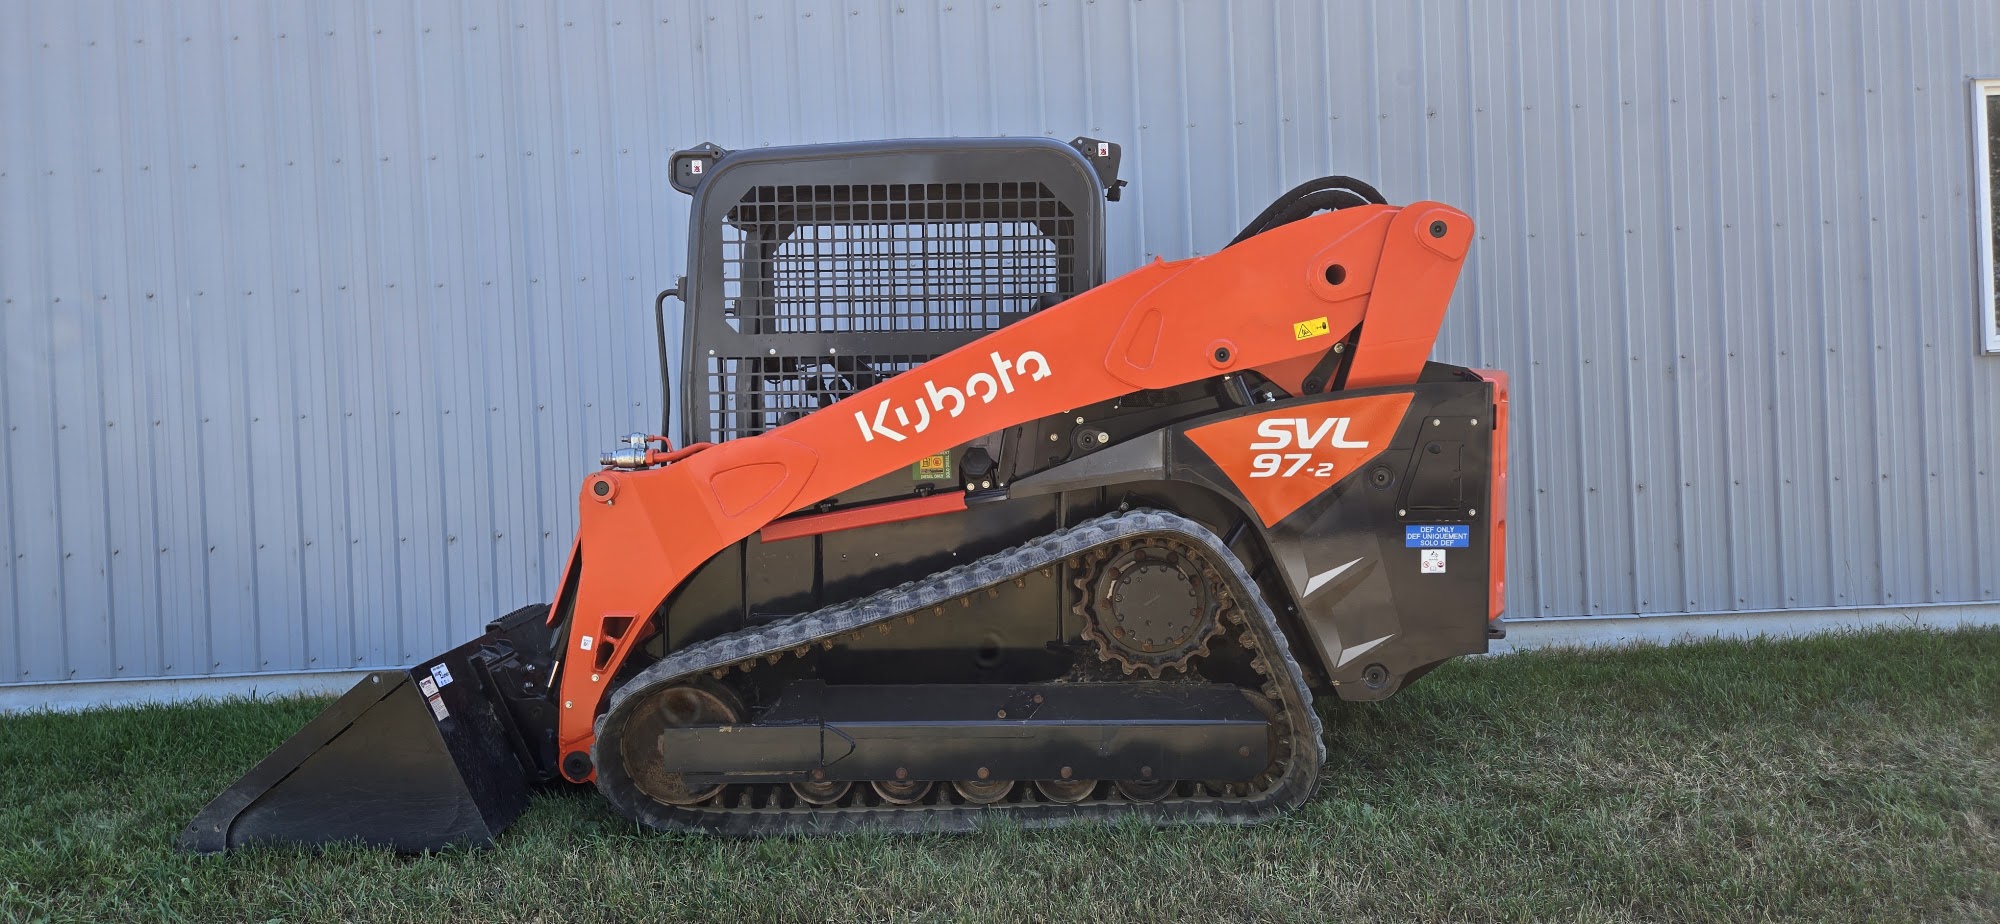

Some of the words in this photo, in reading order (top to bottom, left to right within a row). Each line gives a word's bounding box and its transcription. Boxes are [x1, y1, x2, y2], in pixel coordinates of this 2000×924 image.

[854, 350, 1052, 442] Kubota
[1249, 417, 1369, 450] SVL
[1249, 453, 1334, 478] 97-2
